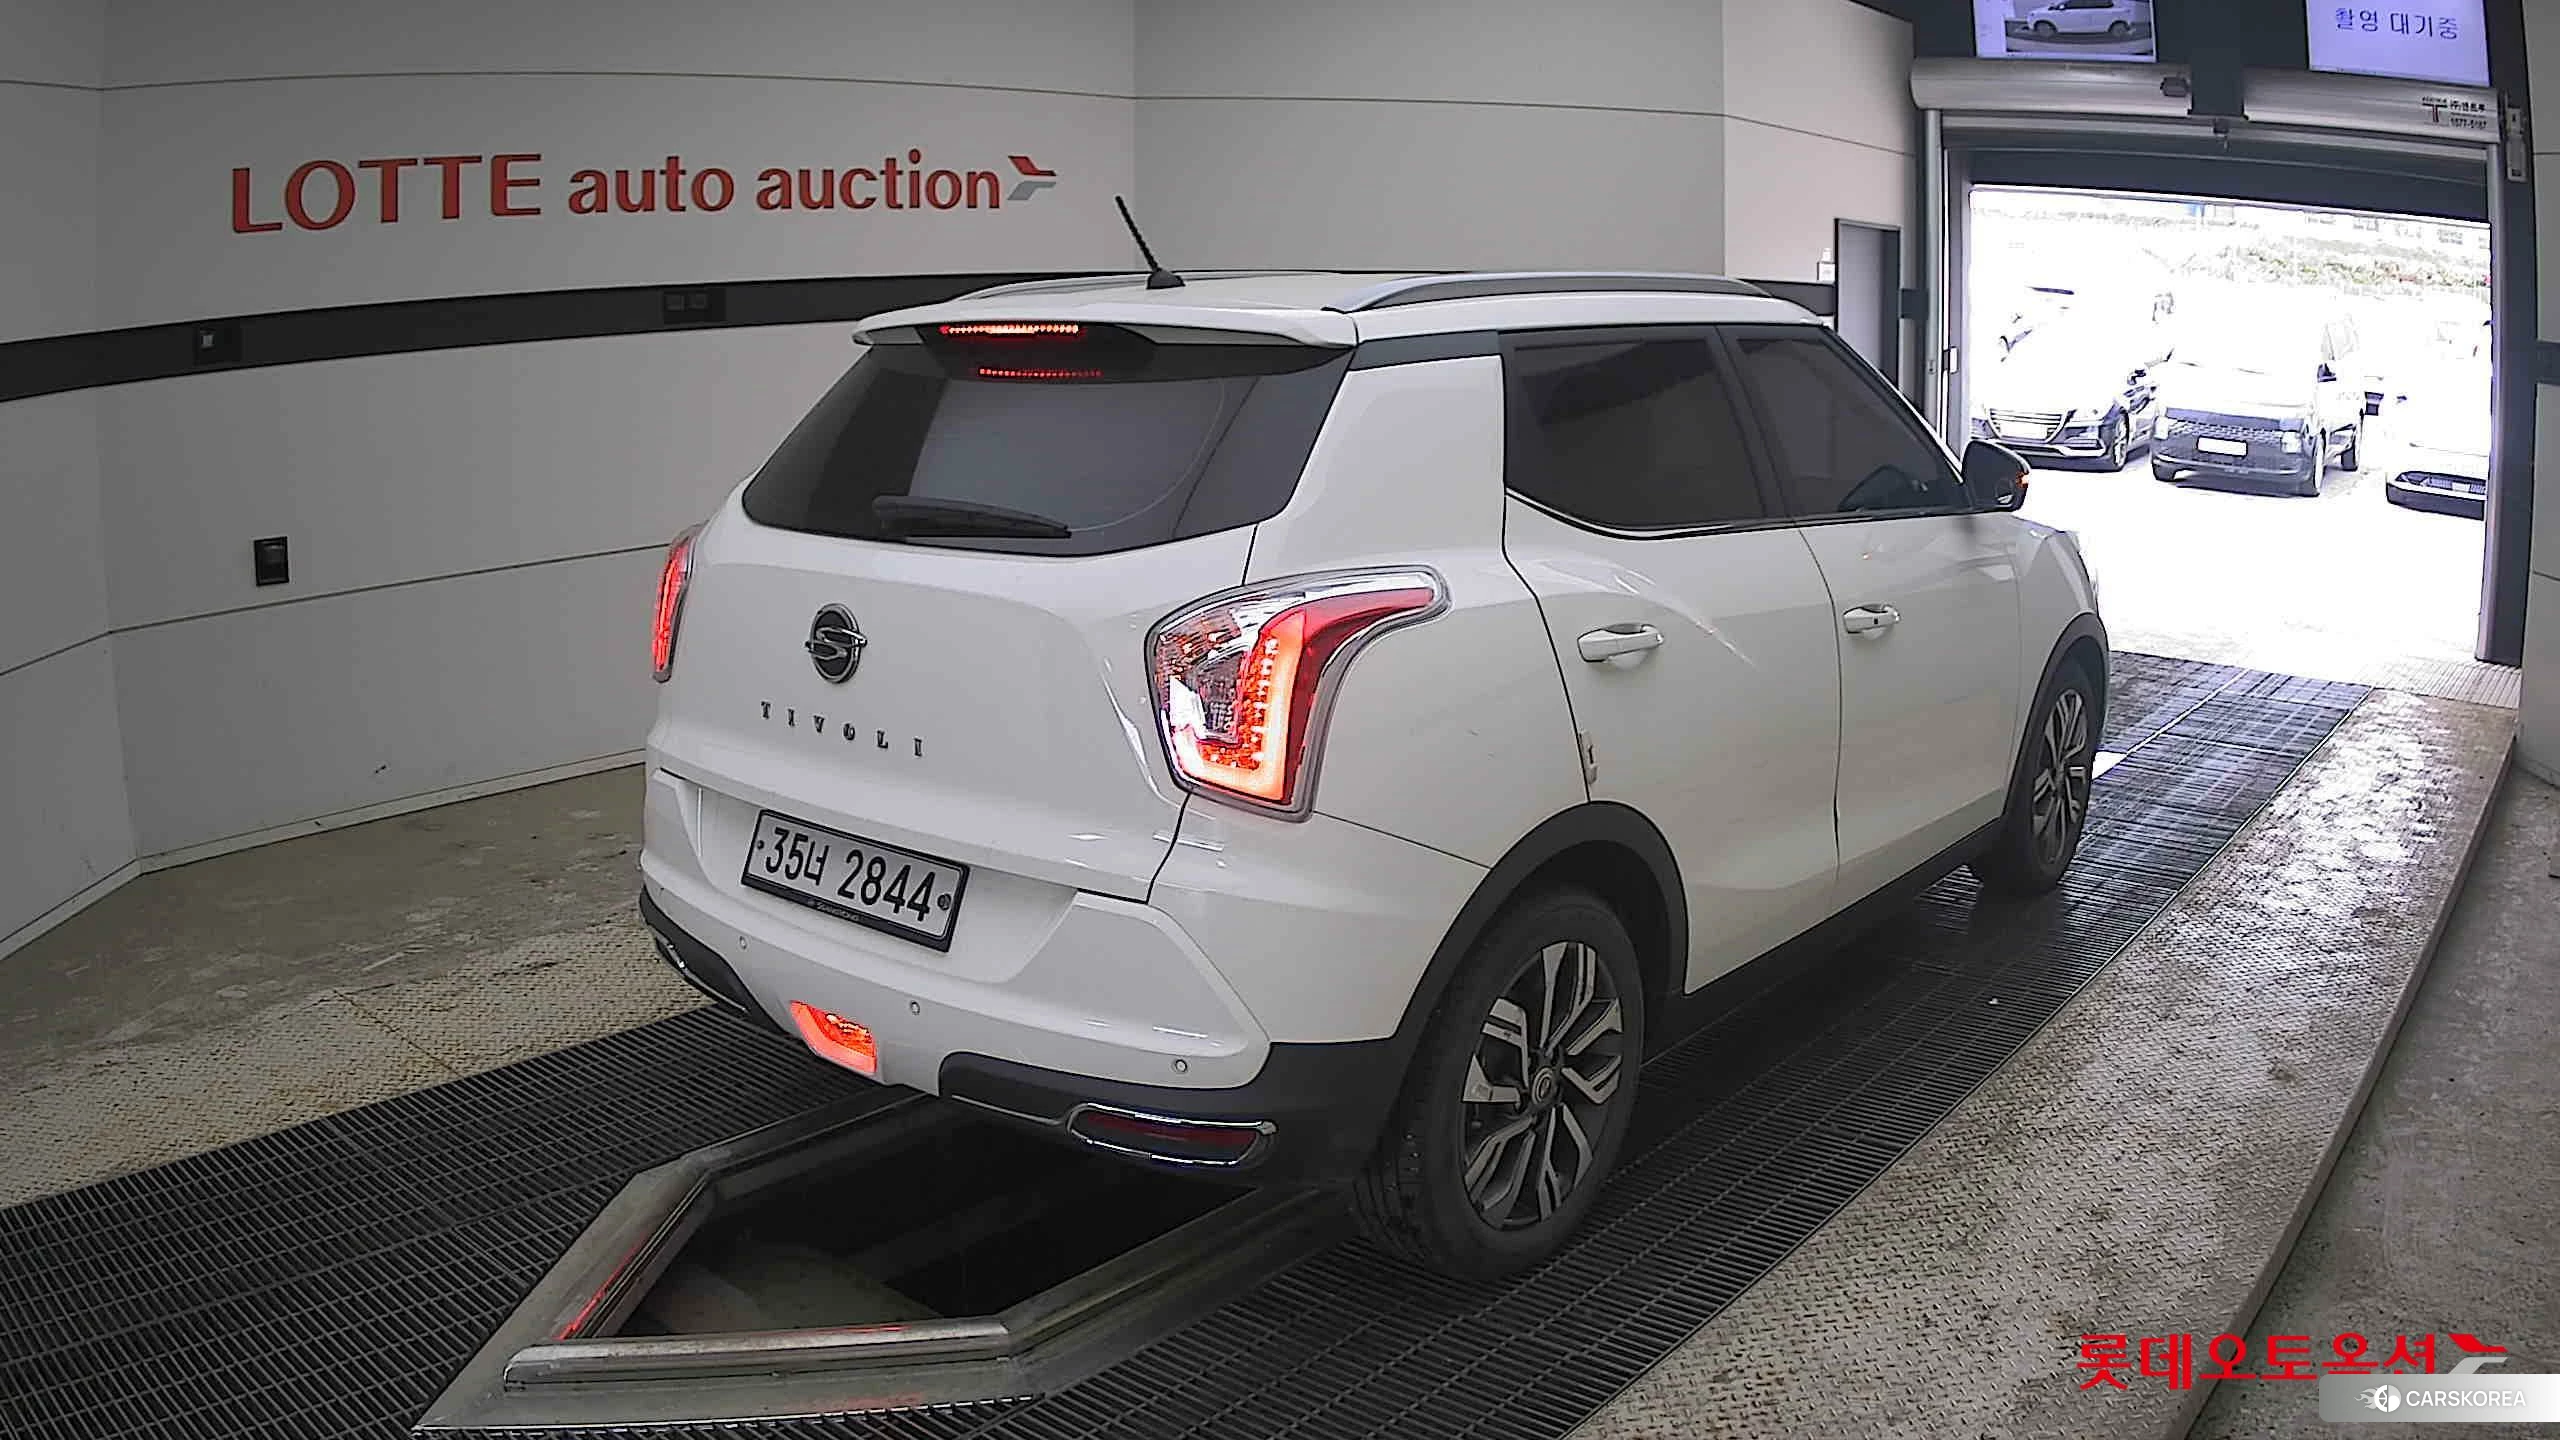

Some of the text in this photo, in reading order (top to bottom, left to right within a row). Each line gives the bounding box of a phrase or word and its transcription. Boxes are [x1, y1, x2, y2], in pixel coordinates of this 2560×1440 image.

[2335, 8, 2458, 40] 촬영 대기중
[232, 149, 1001, 234] LOTTE auto auction
[760, 700, 923, 758] TIVOLI
[764, 826, 936, 922] 35너 2844
